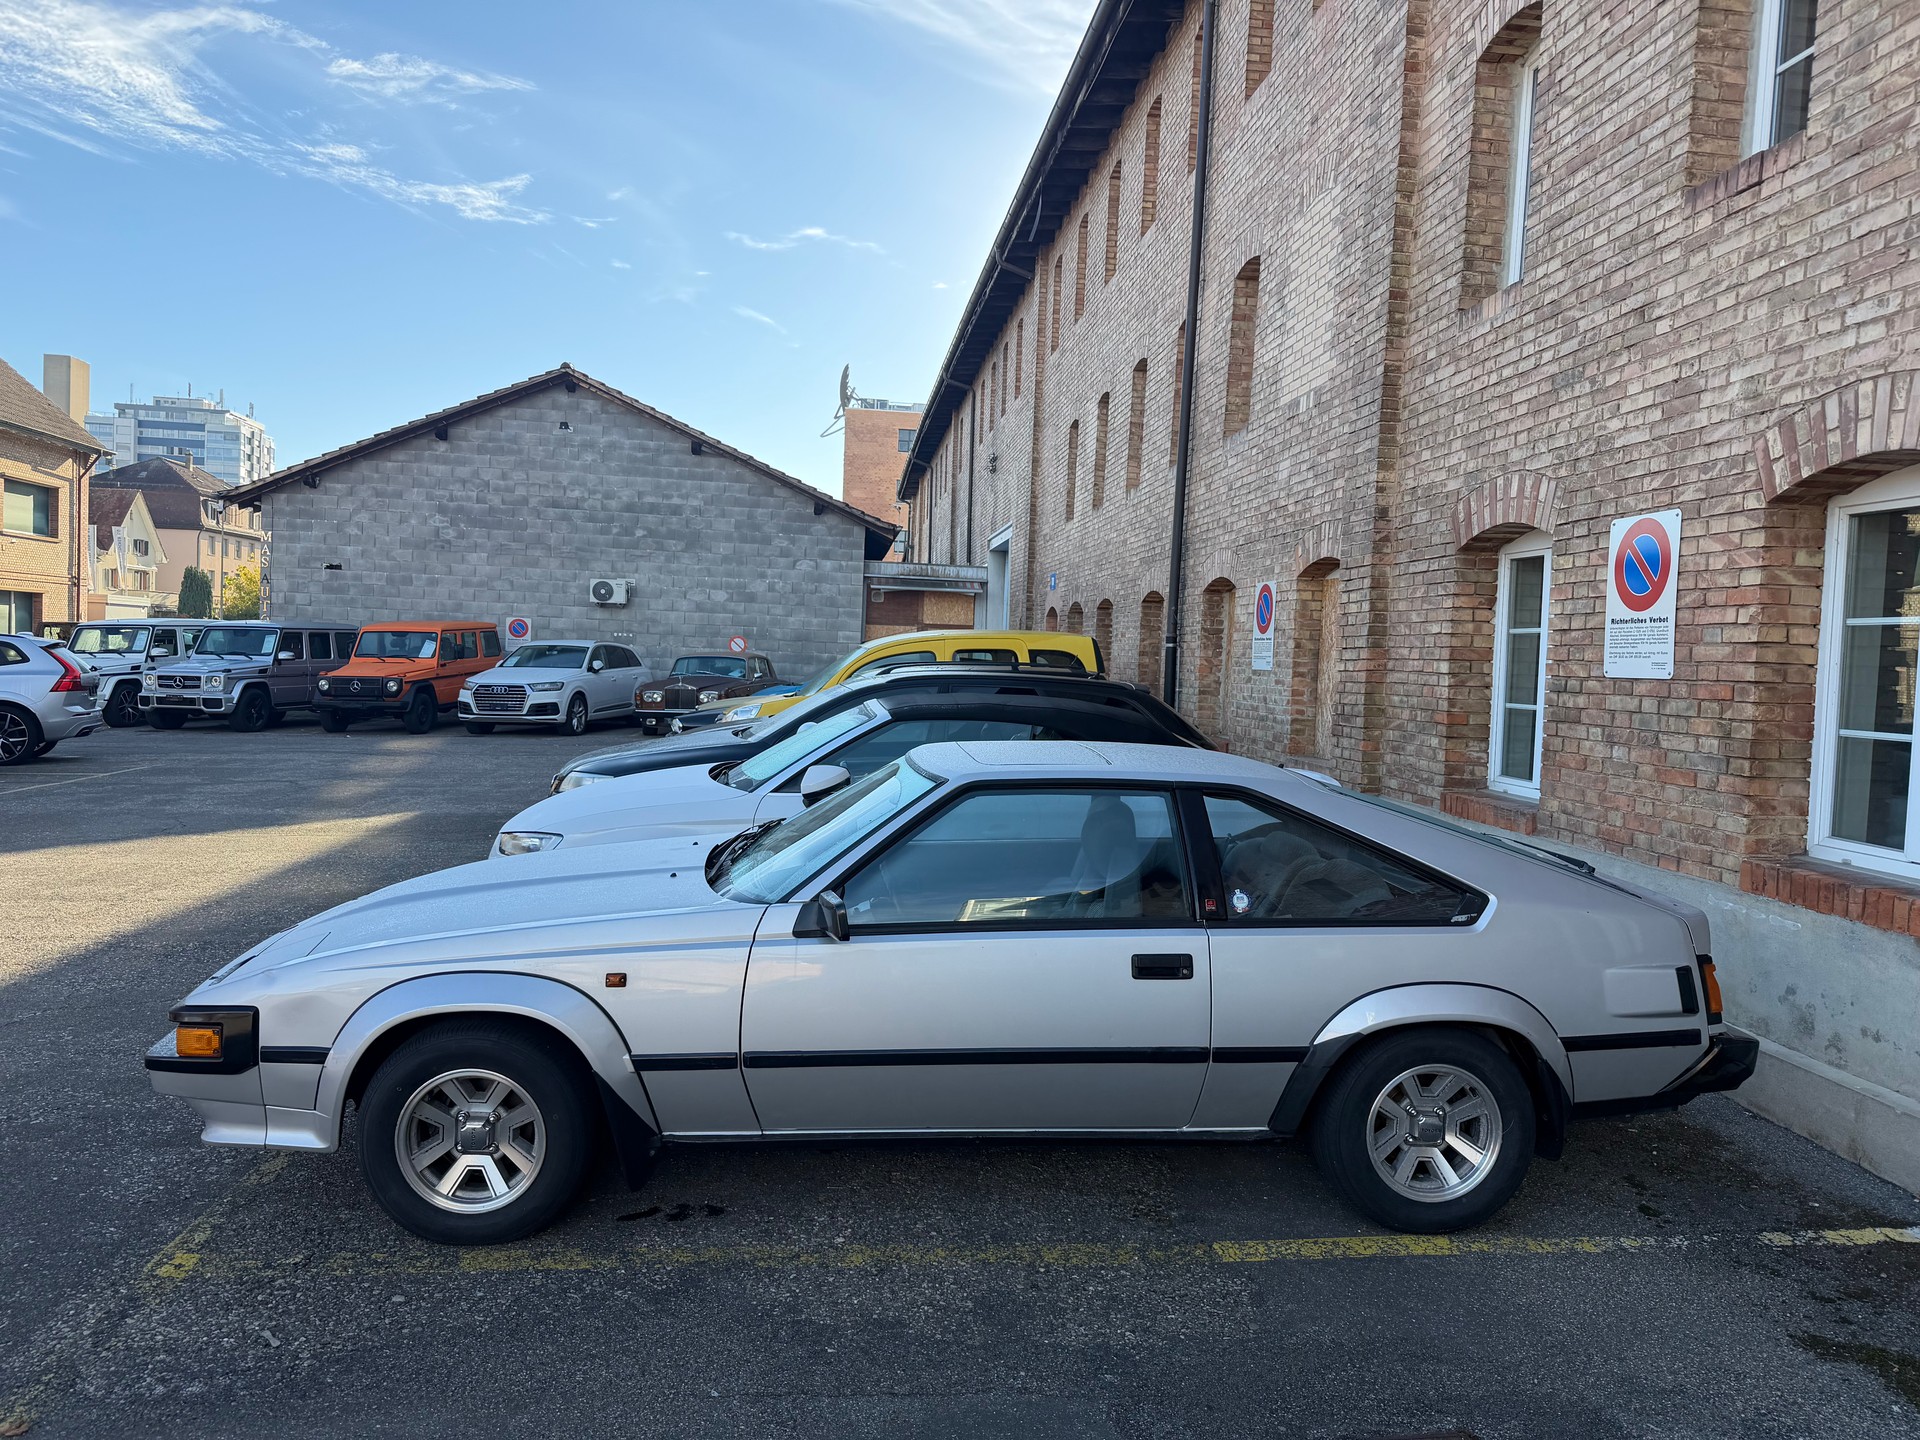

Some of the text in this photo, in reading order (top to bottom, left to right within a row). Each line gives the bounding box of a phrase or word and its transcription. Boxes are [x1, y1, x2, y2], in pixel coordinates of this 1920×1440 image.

[261, 531, 272, 568] MAS
[1611, 616, 1669, 625] Richterliches Verbot
